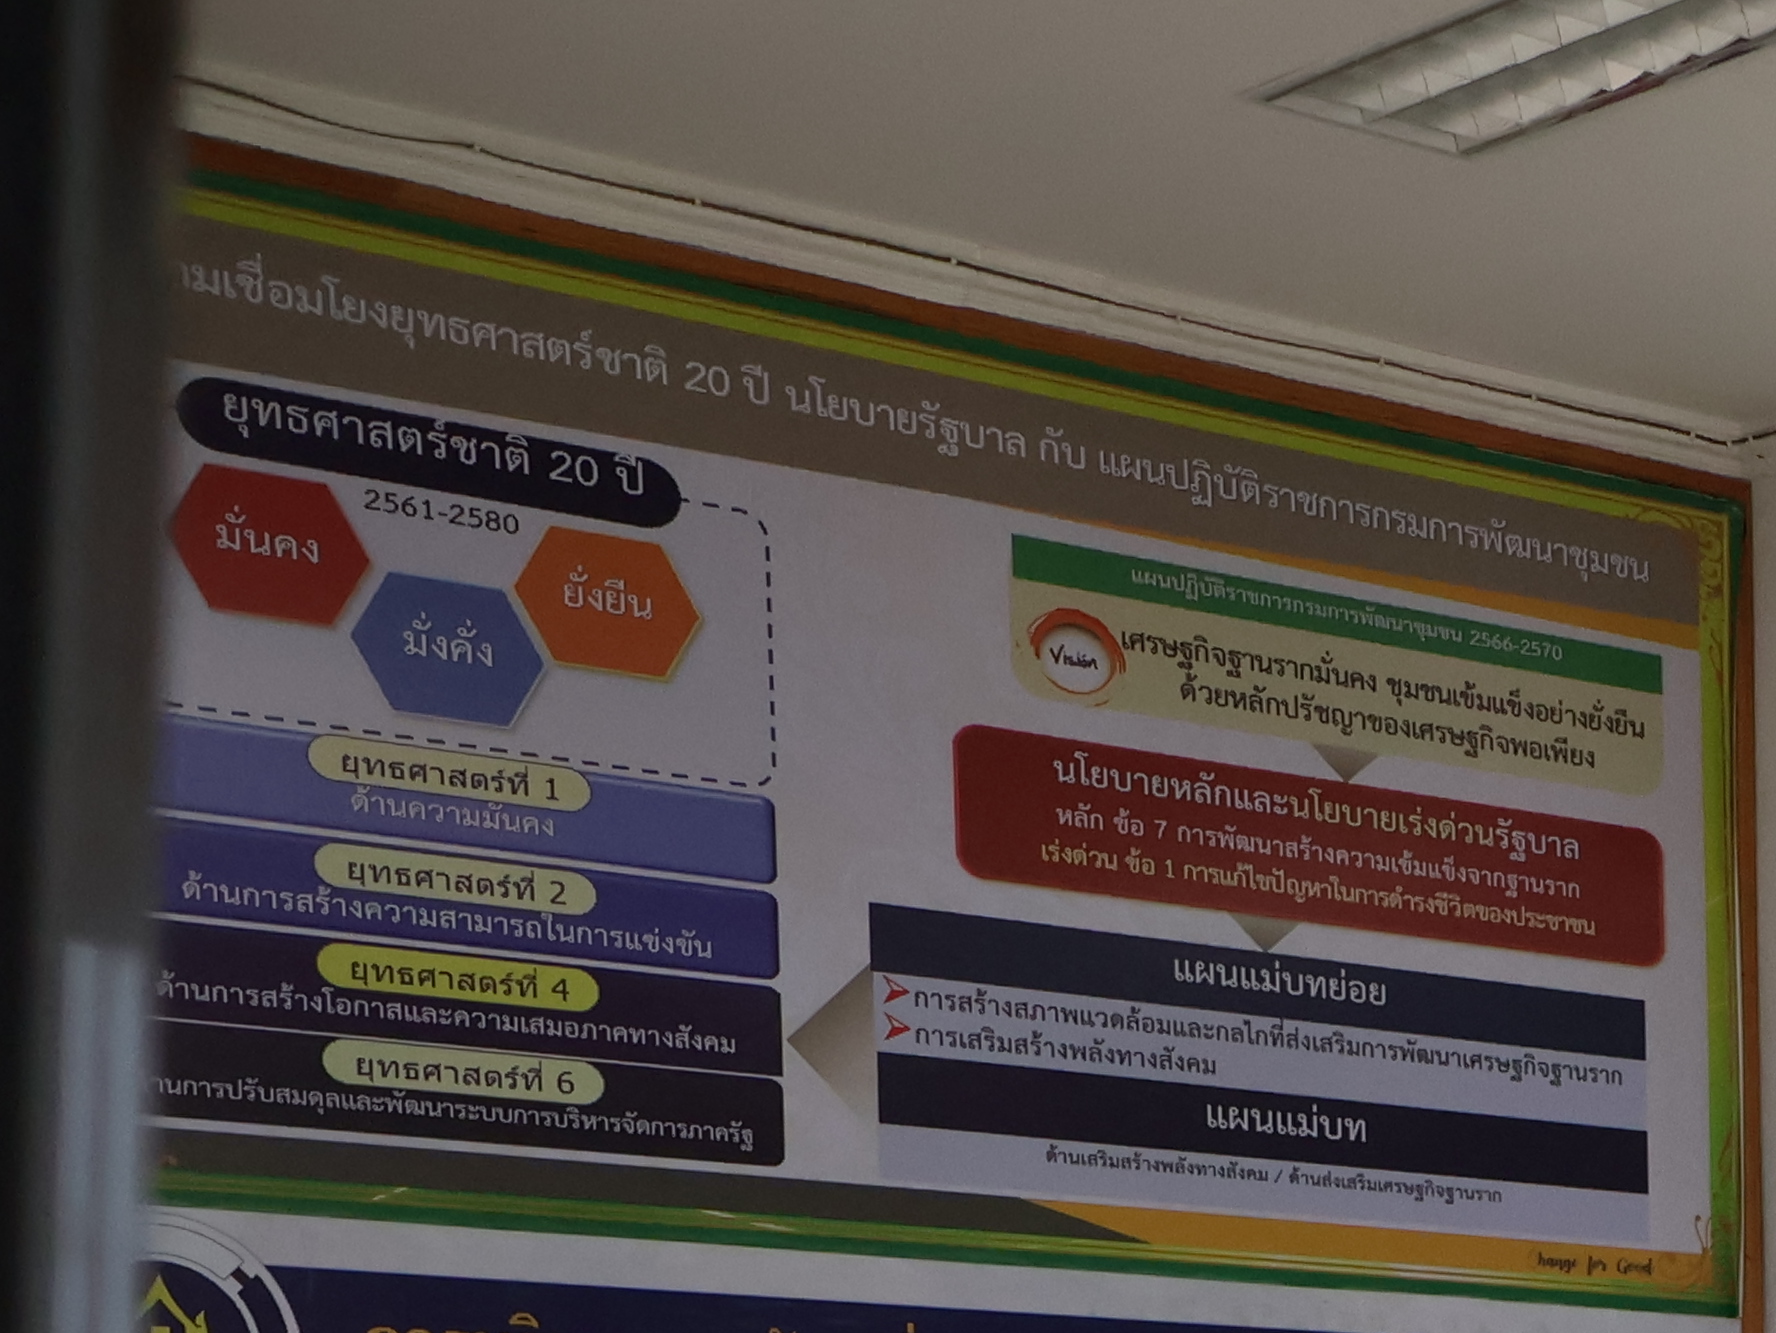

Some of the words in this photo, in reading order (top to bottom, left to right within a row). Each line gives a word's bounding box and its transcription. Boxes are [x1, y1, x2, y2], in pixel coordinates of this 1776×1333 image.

[172, 252, 668, 387] ามเชื่อมโยงยุทธศาสตร์ชาติ
[684, 361, 730, 399] 20
[742, 362, 770, 406] ปี
[785, 377, 1027, 458] นโยบายรัฐบาล
[1039, 427, 1087, 471] กับ
[1099, 446, 1651, 585] แผนปฏิบัติราชการกรมการพัฒนาชุมชน
[222, 391, 532, 477] ยุทธศาสตร์ชาติ
[549, 449, 599, 487] 20
[616, 449, 645, 497] ปี
[215, 505, 320, 564] มั่นคง
[363, 488, 520, 536] 2561-2580
[562, 565, 653, 621] ยั่งยืน
[403, 612, 493, 668] มั่งคั่ง
[1049, 644, 1099, 670] Vision
[1469, 630, 1563, 662] 2566-2570
[1121, 630, 1377, 693] เศรษฐกิจฐานรากมั่นคง
[1386, 677, 1645, 740] ชุมชนเข้มแข็งอย่างยั่งยืน
[1181, 673, 1596, 769] ด้วยหลักปรัชญาของเศรษฐกิจพอเพียง
[340, 748, 531, 799] ยุทธศาสตร์ที่
[544, 776, 560, 800] 1
[350, 785, 555, 837] ด้านความมั่นคง
[1053, 752, 1580, 861] นโยบายหลักและนโยบายเร่งด่วนรัฐบาล
[1041, 841, 1118, 872] เร่งด่วน
[1125, 846, 1156, 875] ข้อ
[1164, 859, 1175, 878] 1
[1056, 801, 1104, 832] หลัก
[1113, 809, 1144, 838] ข้อ
[1154, 819, 1167, 840] 7
[1177, 822, 1580, 899] การพัฒนาสร้างความเข้มแข็งจากฐานราก
[347, 855, 542, 904] ยุทธศาสตร์ที่
[549, 880, 568, 905] 2
[181, 871, 713, 960] ด้านการสร้างความสามารถในการแข่งขัน
[350, 956, 545, 1000] ยุทธศาสตร์ที่
[550, 977, 570, 1002] 4
[1173, 953, 1387, 1007] แผนแม่บทย่อย
[356, 1052, 548, 1095] ยุทธศาสตร์ที่
[557, 1070, 577, 1096] 6
[914, 1021, 1217, 1077] การเสริมสร้างพลังทางสังคม
[154, 1077, 755, 1151] านการปรับสมดุลและพัฒนาระบบการบริหารจัดการภาครัฐ
[1205, 1103, 1368, 1144] แผนแม่บท
